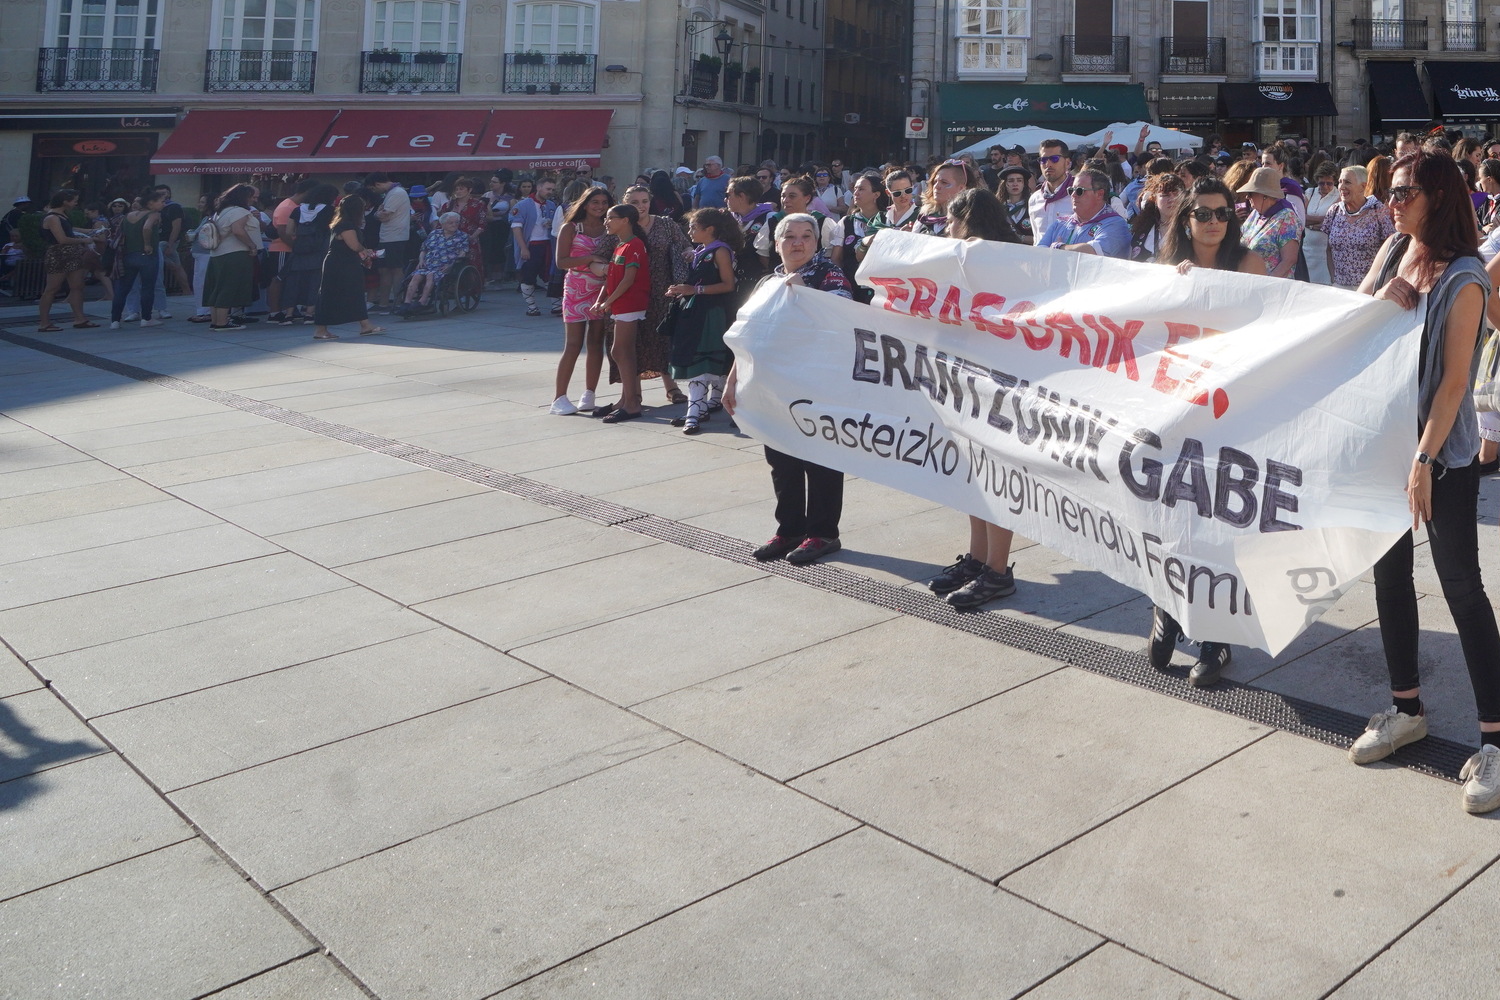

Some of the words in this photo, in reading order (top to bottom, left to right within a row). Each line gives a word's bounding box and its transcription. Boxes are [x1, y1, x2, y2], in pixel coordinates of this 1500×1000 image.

[1457, 87, 1499, 99] güreik
[993, 97, 1029, 111] café
[1050, 97, 1099, 111] dublin
[168, 165, 273, 173] www.ferrettivitoria.com
[529, 160, 557, 169] gelato
[852, 328, 1110, 484] ERANTZUNIK
[1118, 428, 1303, 533] GABE
[789, 399, 960, 476] Gasteizko
[967, 439, 1141, 568] Mugimendu
